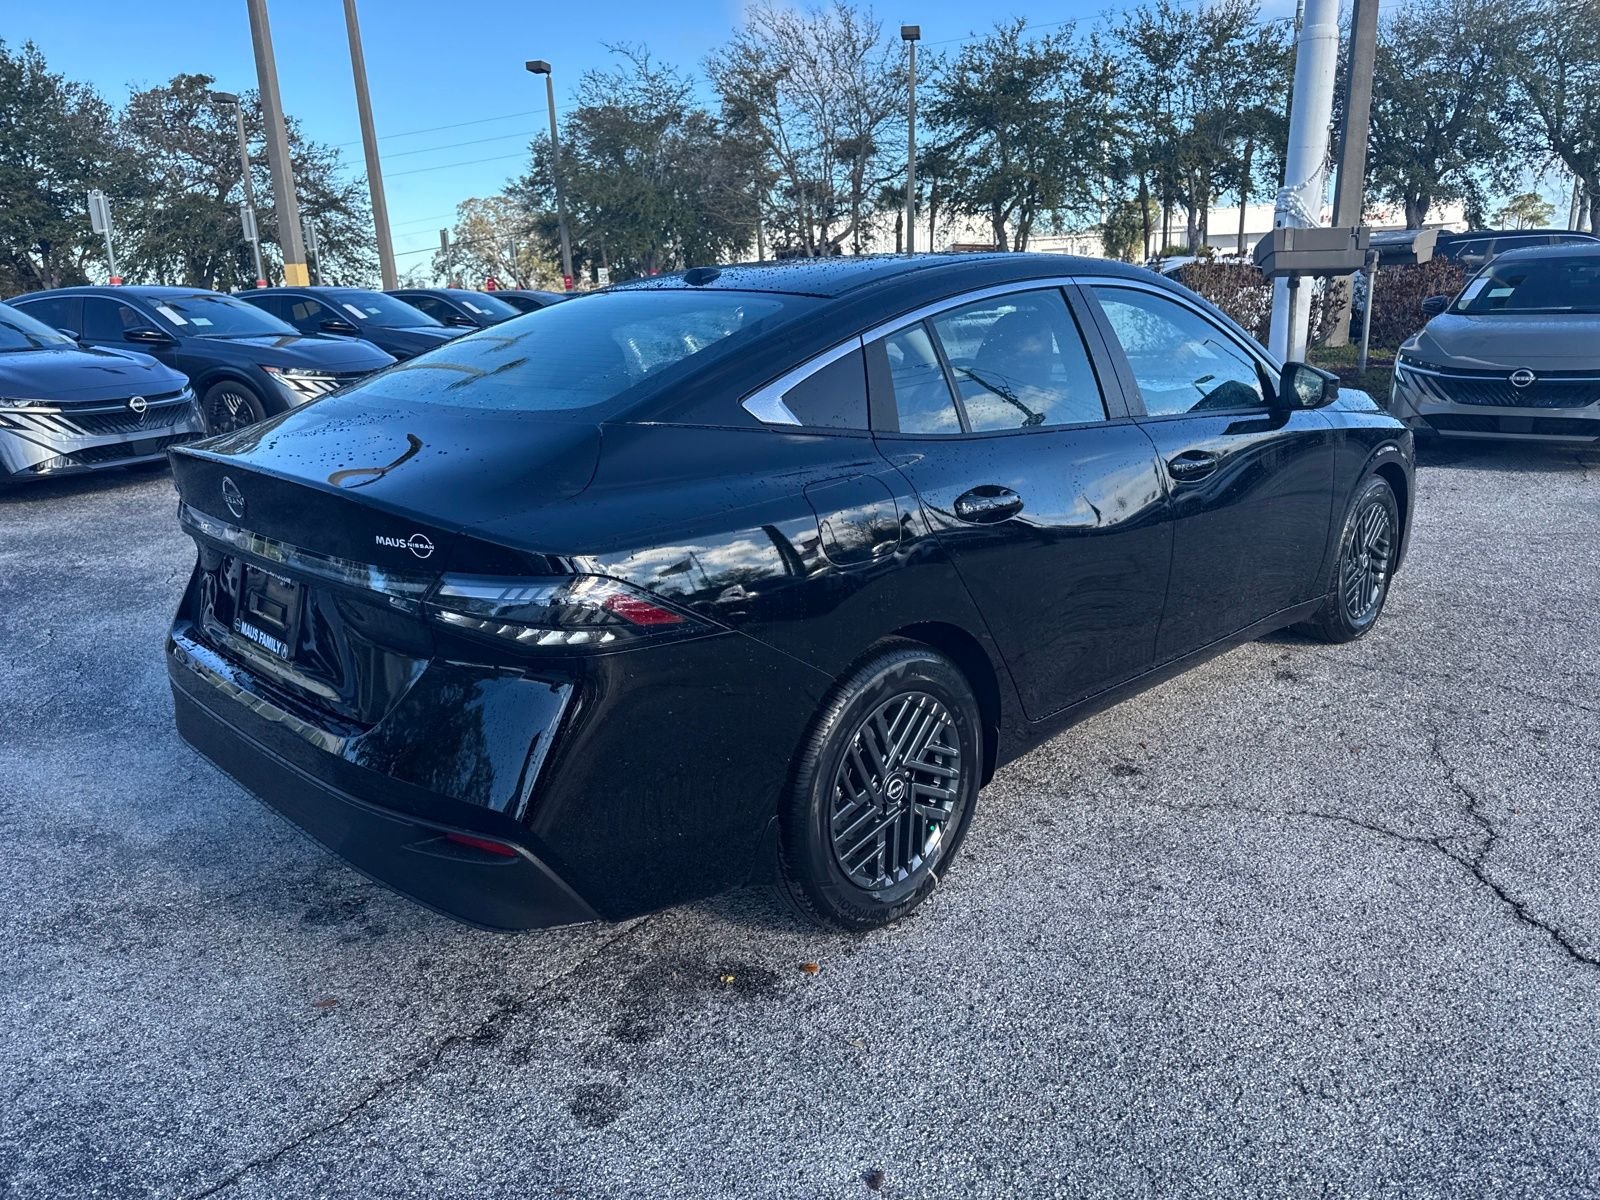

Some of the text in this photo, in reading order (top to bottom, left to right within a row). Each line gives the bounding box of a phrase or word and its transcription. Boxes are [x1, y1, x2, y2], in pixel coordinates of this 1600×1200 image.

[375, 535, 435, 550] MAUS NISSAN
[240, 621, 282, 654] MAUS FAMILY
